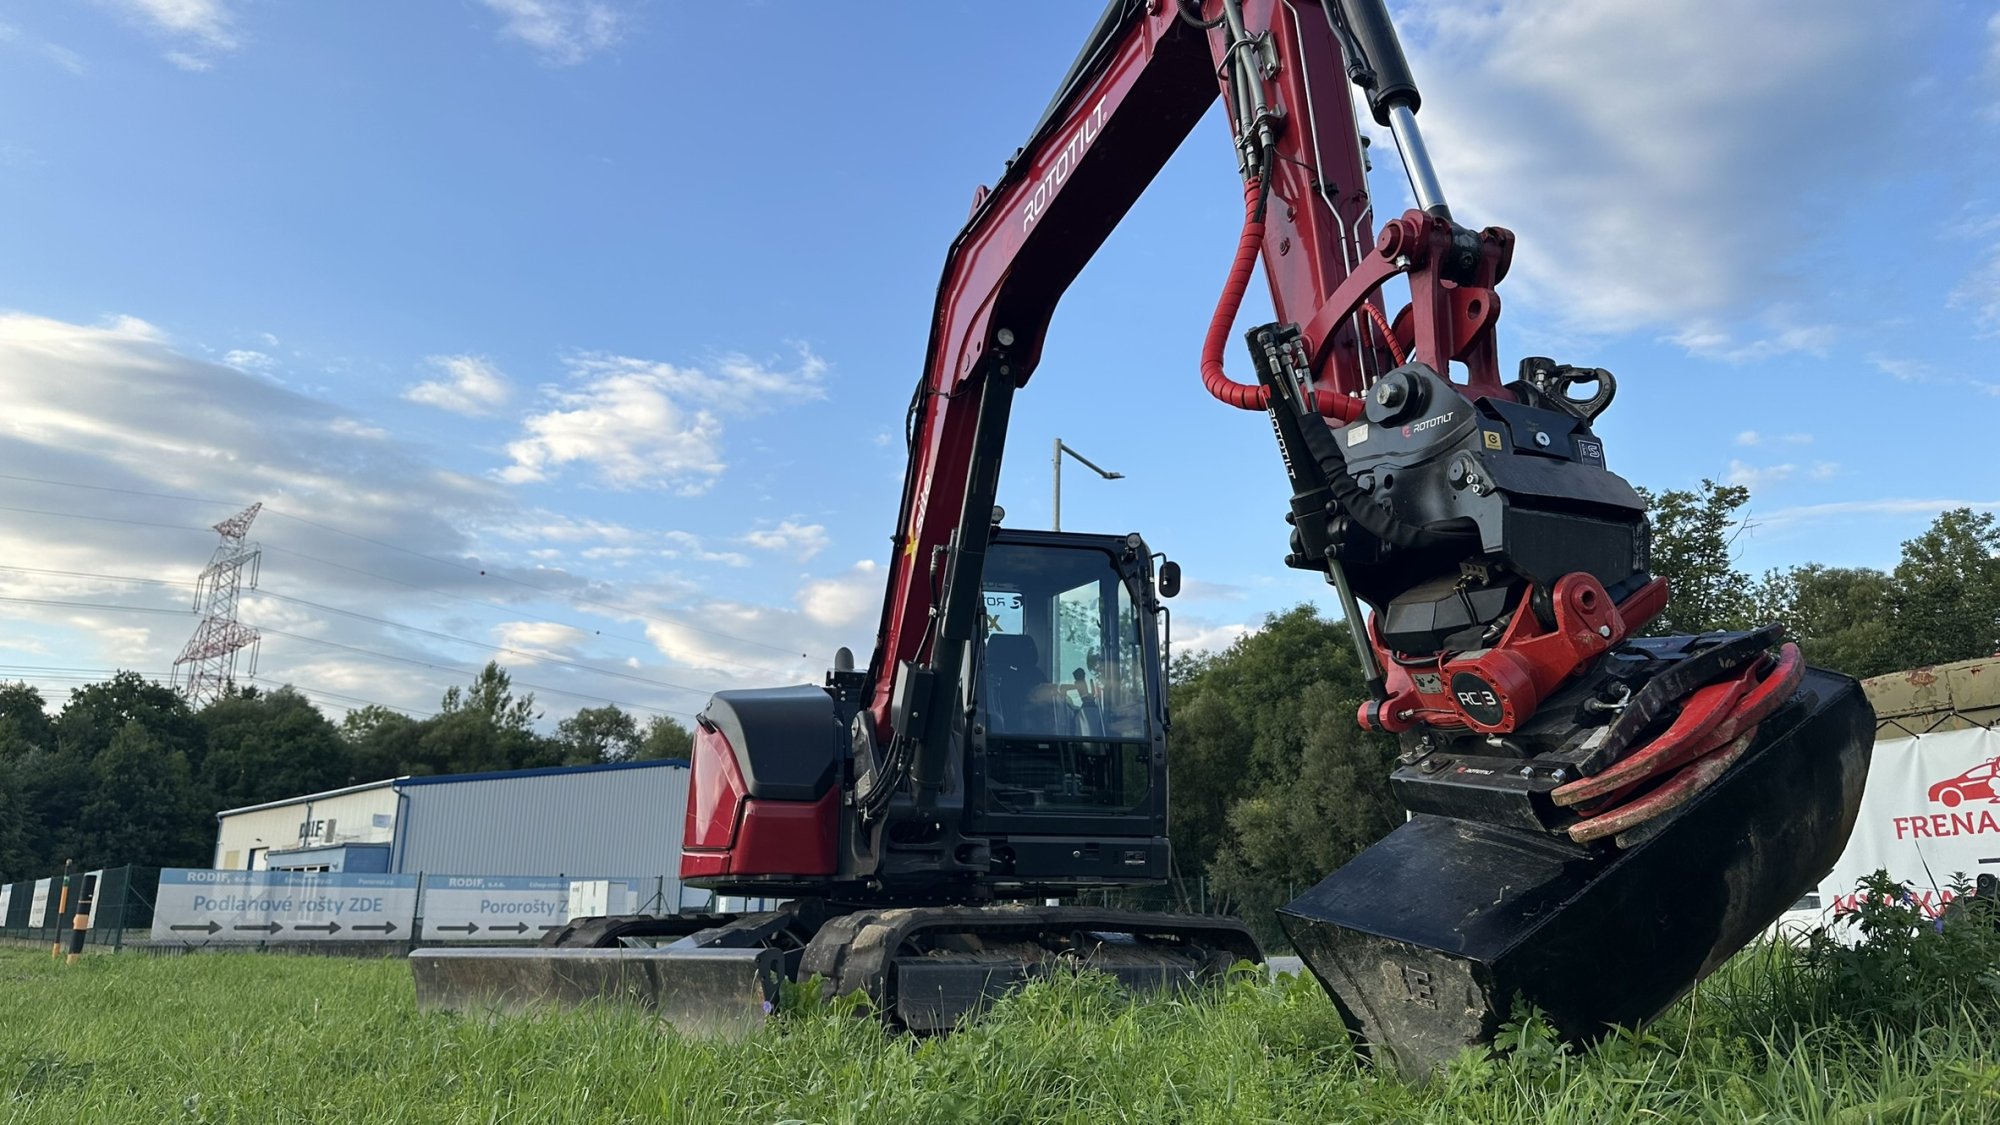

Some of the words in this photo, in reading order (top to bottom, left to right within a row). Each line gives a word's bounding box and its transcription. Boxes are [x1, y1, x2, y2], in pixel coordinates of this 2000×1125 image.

[1413, 412, 1454, 433] ROTOTILT
[187, 871, 231, 884] RODIF,
[448, 877, 486, 889] RODIF,
[193, 895, 291, 913] Podlahové
[300, 895, 344, 917] rošty
[348, 897, 383, 913] ZDE
[480, 898, 555, 917] Pororošty
